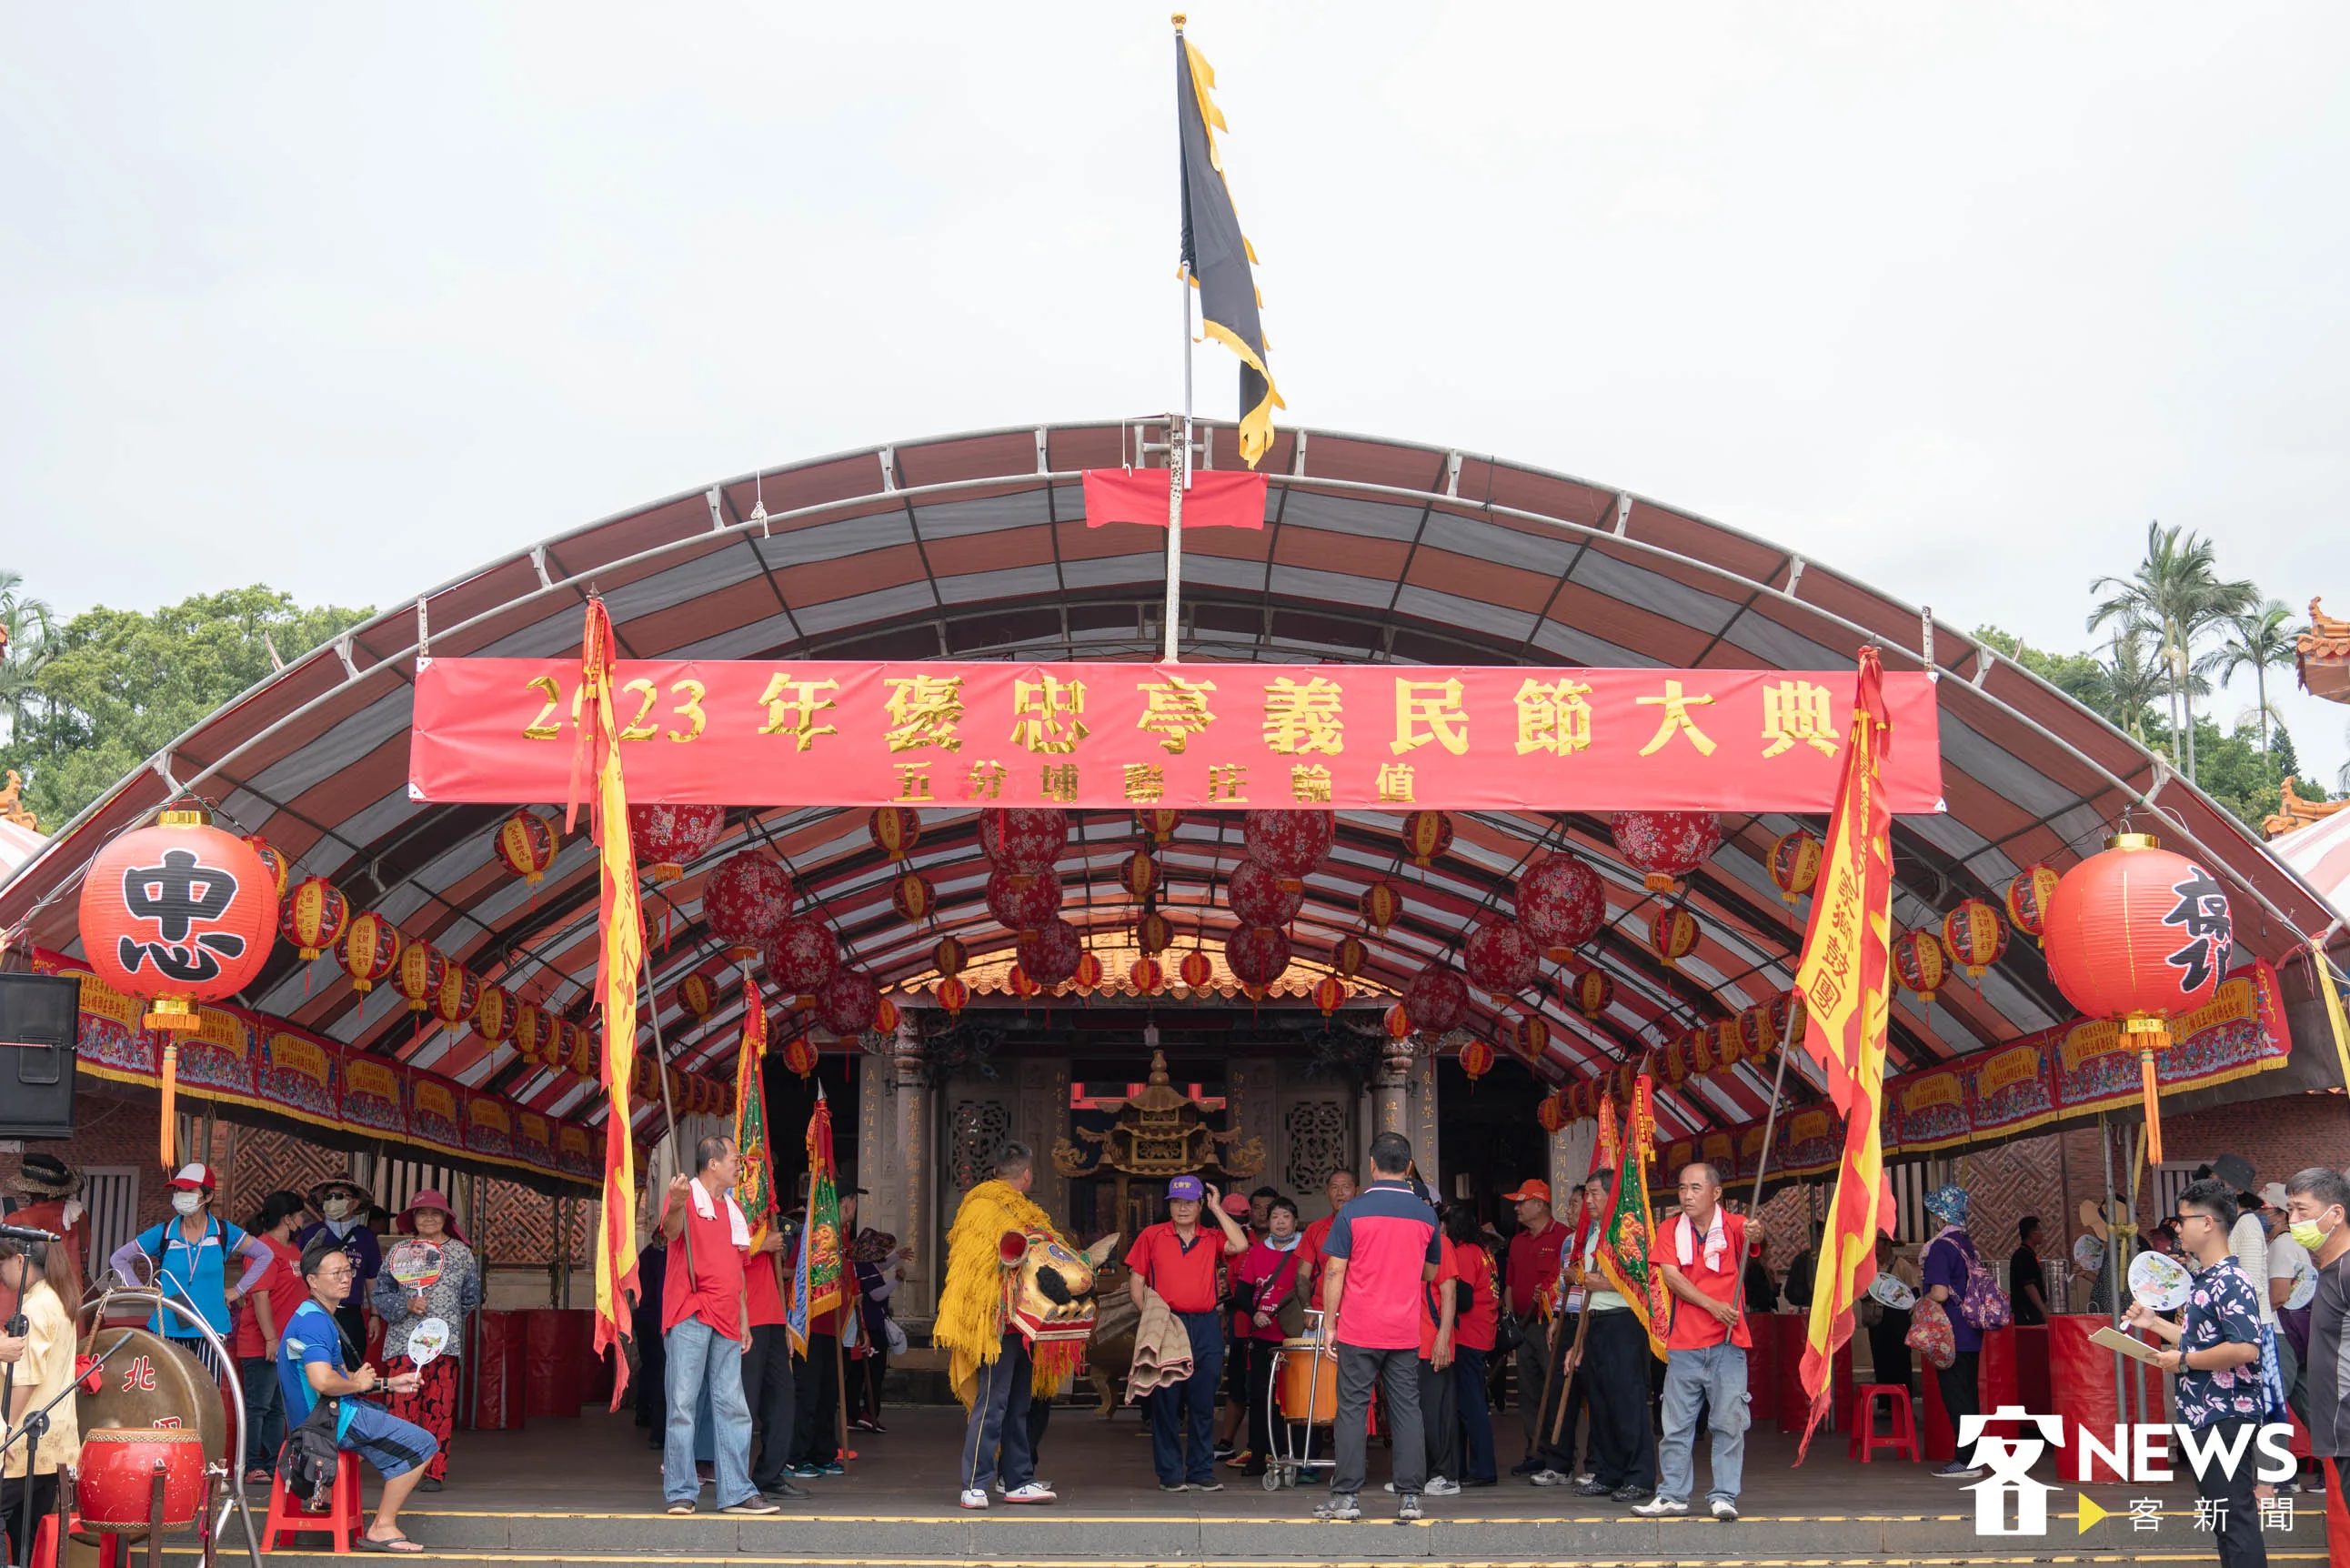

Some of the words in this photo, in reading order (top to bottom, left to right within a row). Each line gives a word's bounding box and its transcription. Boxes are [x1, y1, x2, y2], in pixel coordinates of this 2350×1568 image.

[522, 672, 1840, 759] 223年褒忠亭義民節大典
[117, 848, 246, 982] 忠
[122, 1355, 156, 1392] 北
